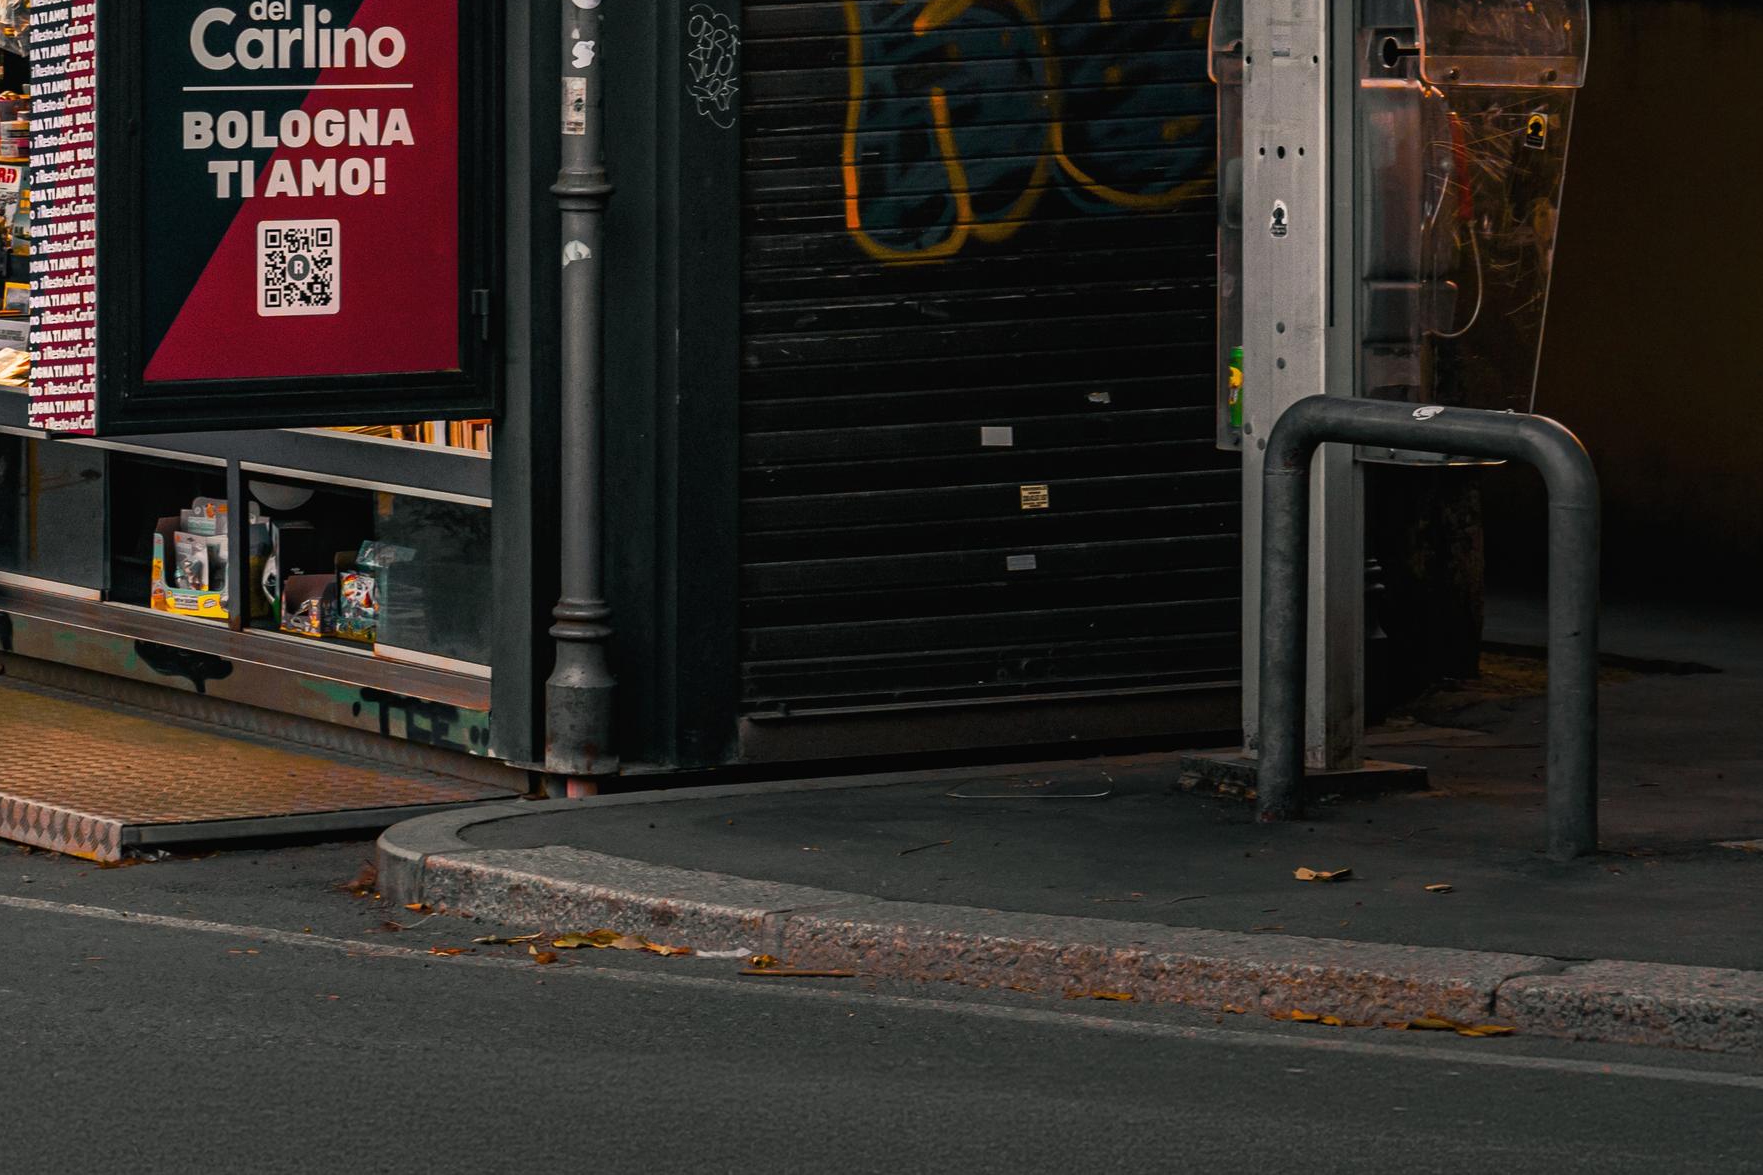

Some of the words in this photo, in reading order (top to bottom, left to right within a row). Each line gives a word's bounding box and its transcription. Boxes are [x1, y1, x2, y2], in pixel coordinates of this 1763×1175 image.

[190, 4, 406, 71] Carlino
[182, 108, 416, 150] BOLOGNA
[207, 159, 255, 199] TI
[264, 157, 386, 198] AMO!
